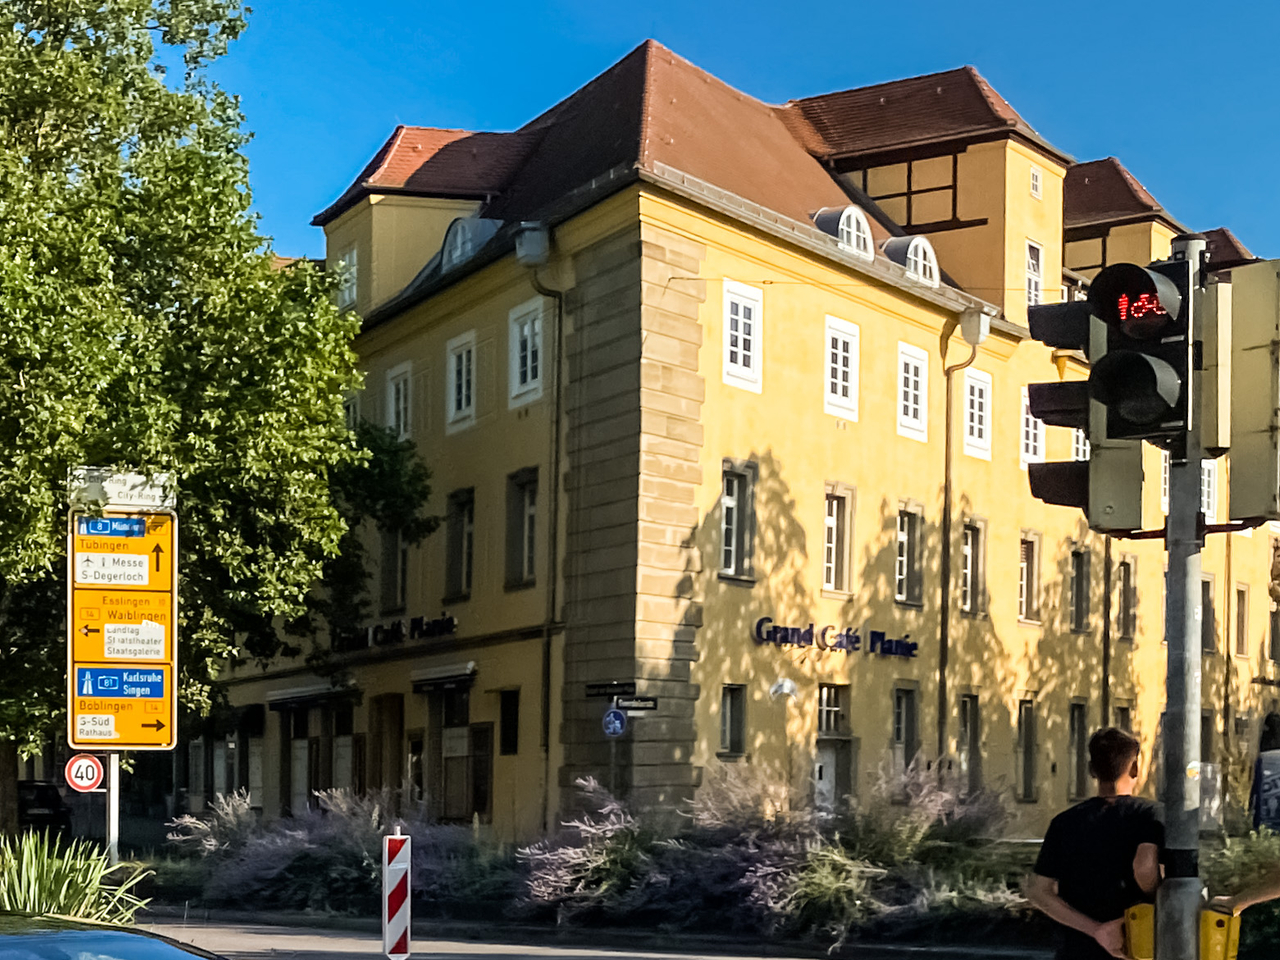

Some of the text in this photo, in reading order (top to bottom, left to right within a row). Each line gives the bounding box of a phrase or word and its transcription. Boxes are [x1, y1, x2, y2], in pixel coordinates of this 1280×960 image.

[112, 557, 144, 567] Messe
[81, 570, 144, 582] S-Degerloch
[102, 596, 150, 607] Esslingen
[107, 610, 166, 621] Waiblingen
[755, 617, 814, 647] Grand
[819, 626, 861, 651] Café
[107, 646, 161, 656] Staatsgalerie
[104, 671, 162, 687] 81 Karlsruhe
[123, 684, 151, 697] Singen
[80, 716, 110, 726] S-Süd
[79, 728, 112, 736] Rathaus
[74, 765, 95, 781] 40
